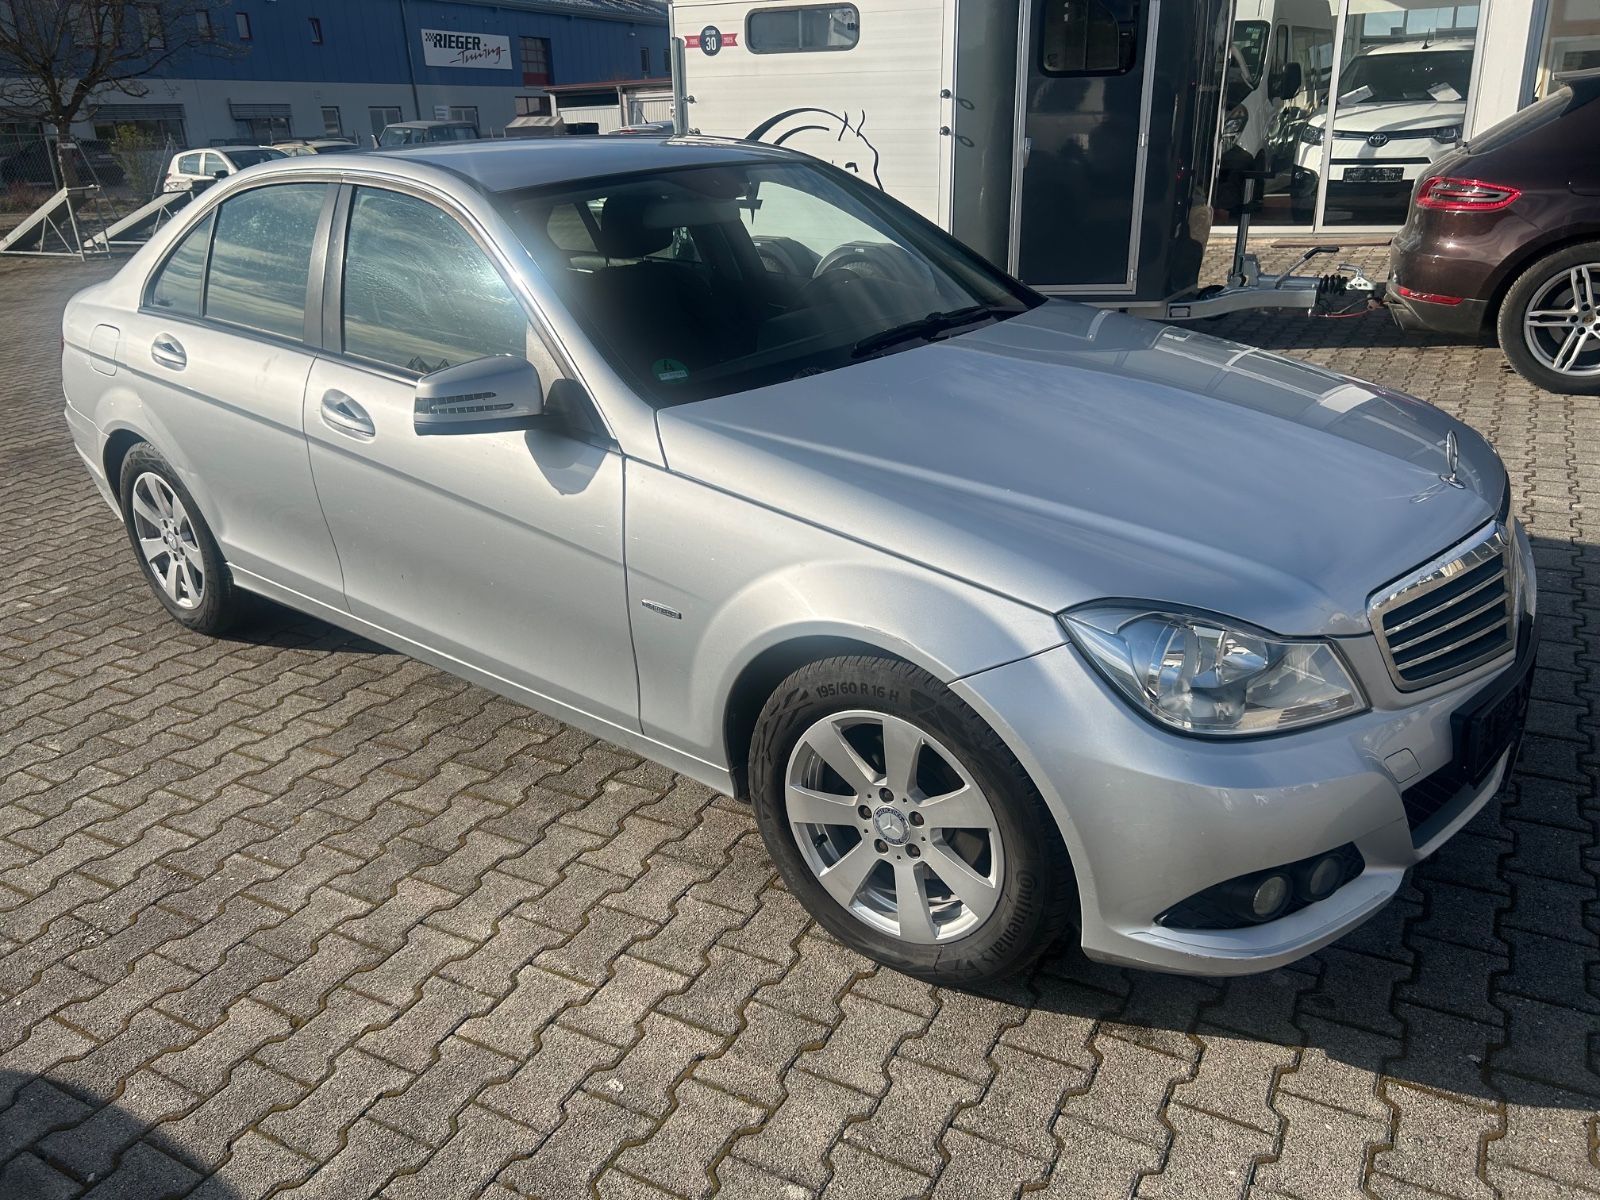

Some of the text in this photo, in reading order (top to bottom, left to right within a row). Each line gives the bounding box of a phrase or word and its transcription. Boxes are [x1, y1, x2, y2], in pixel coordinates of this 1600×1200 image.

[433, 33, 481, 50] RIEGER
[705, 37, 717, 50] 30
[450, 43, 507, 65] Tuning
[816, 682, 900, 701] 195/60 R 16 H
[988, 868, 1038, 960] Continental
